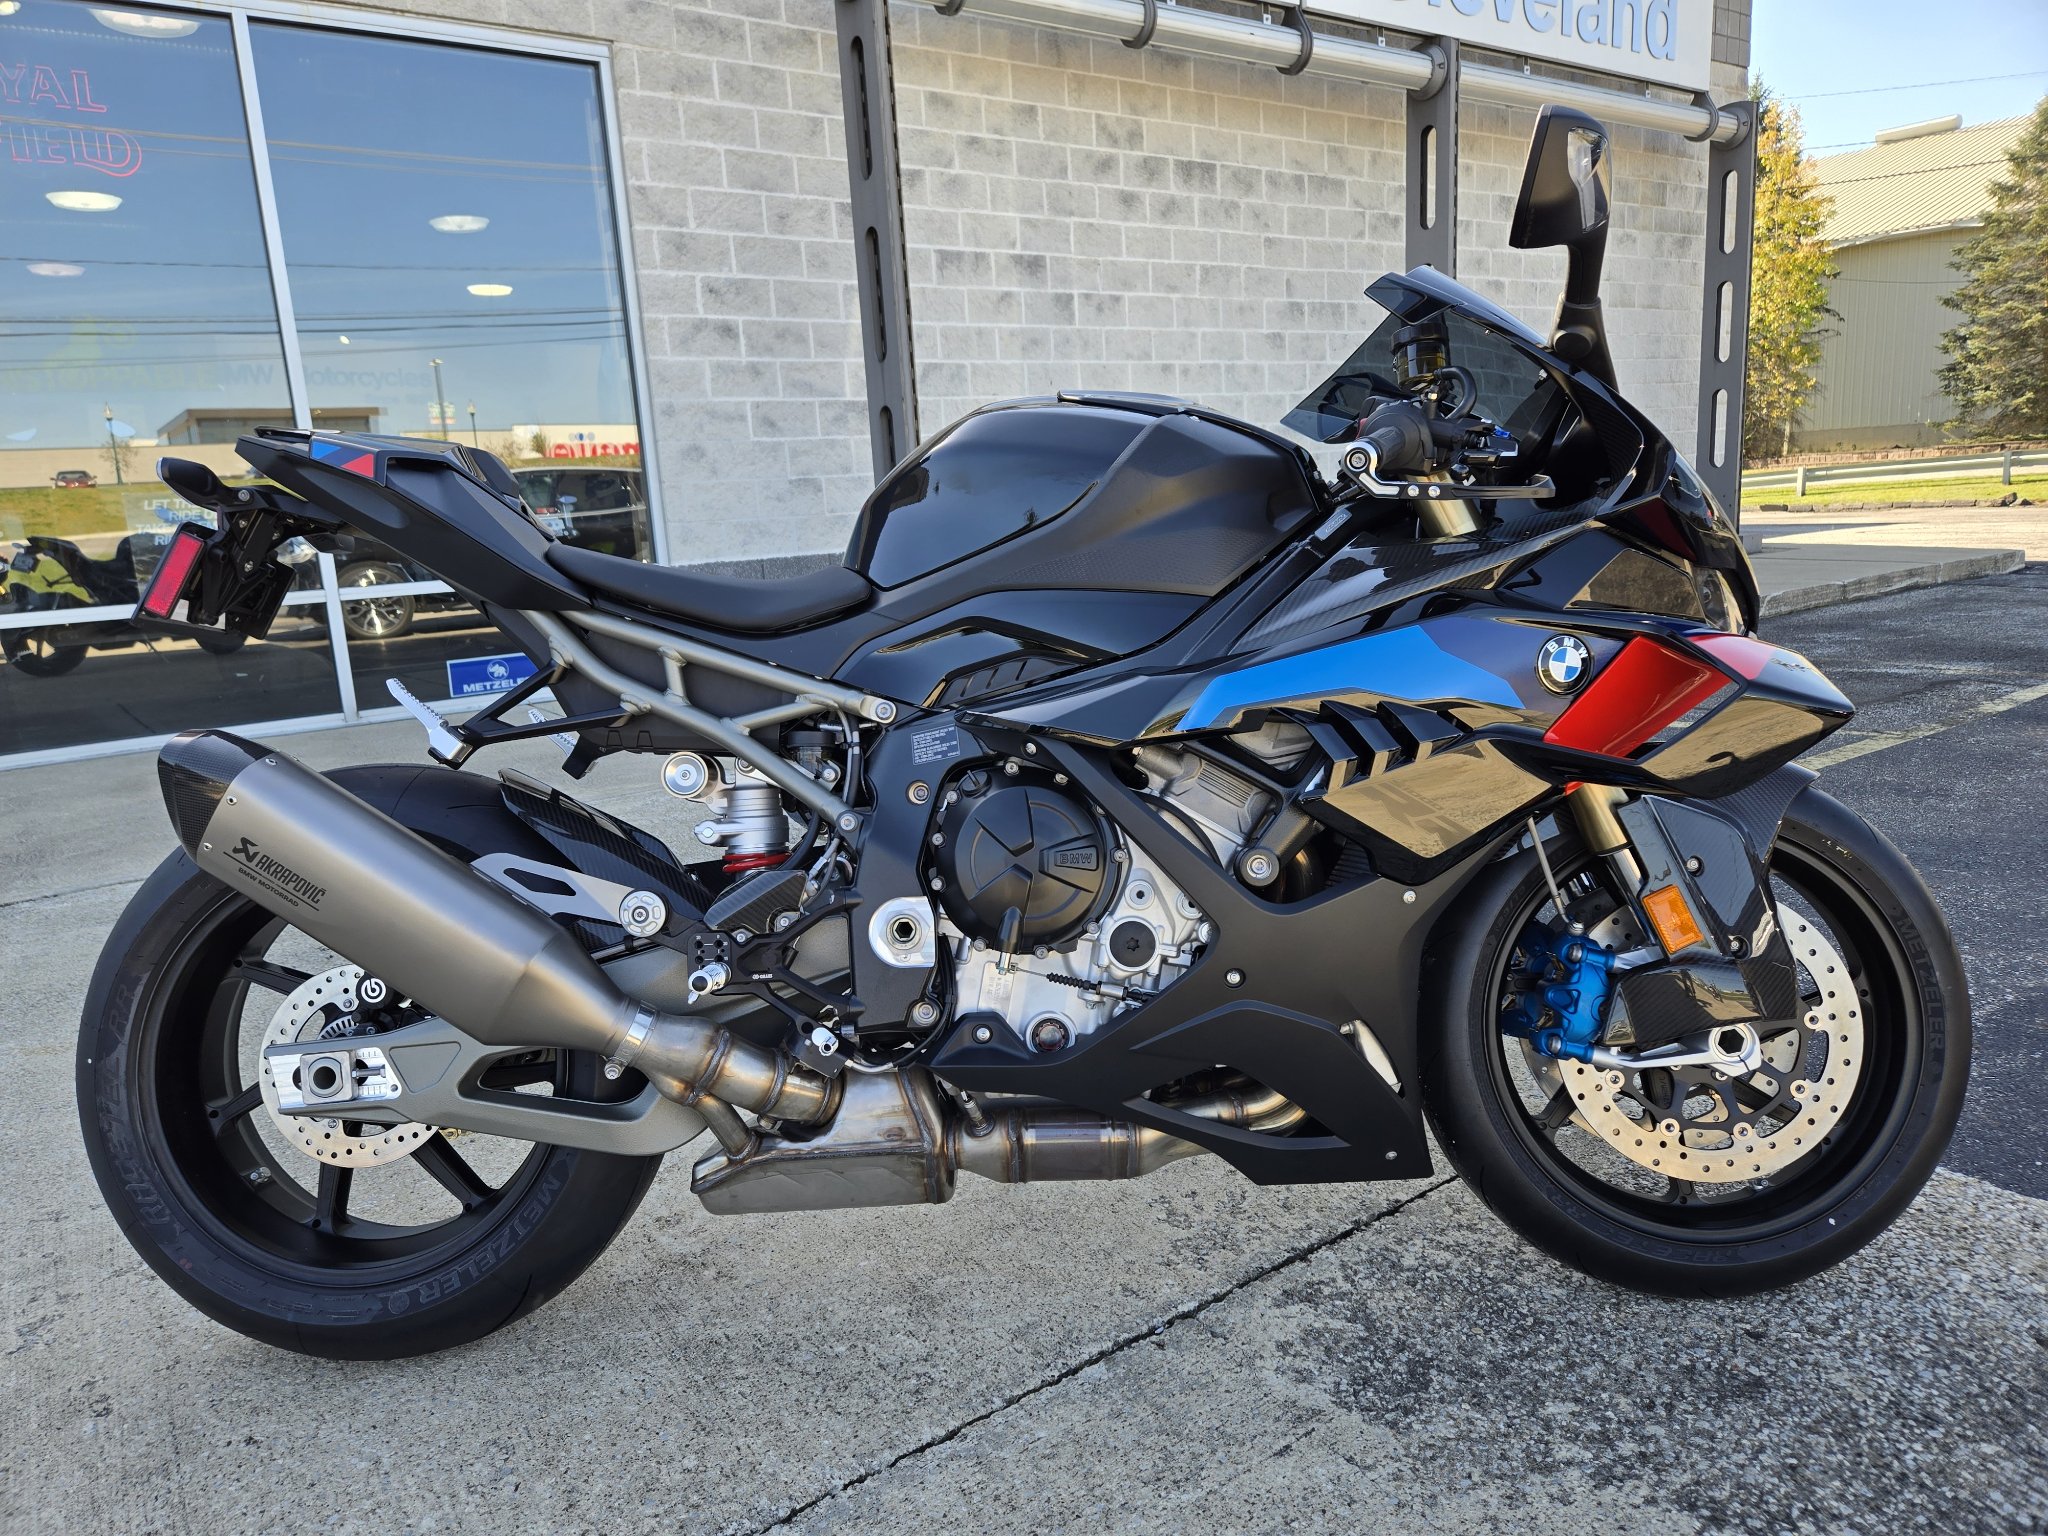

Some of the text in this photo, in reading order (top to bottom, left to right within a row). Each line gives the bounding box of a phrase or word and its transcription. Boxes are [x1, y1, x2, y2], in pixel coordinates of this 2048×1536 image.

[0, 122, 143, 177] IELD
[303, 366, 432, 392] otorcycles
[143, 498, 170, 511] LET
[168, 508, 200, 521] RIDE
[1546, 637, 1588, 658] BMW
[463, 677, 531, 693] METZELE
[1059, 852, 1093, 864] BMW
[238, 867, 299, 907] BMW MOTORRAD
[1895, 916, 1946, 1051] METZELER
[417, 1174, 564, 1304] METZELER
